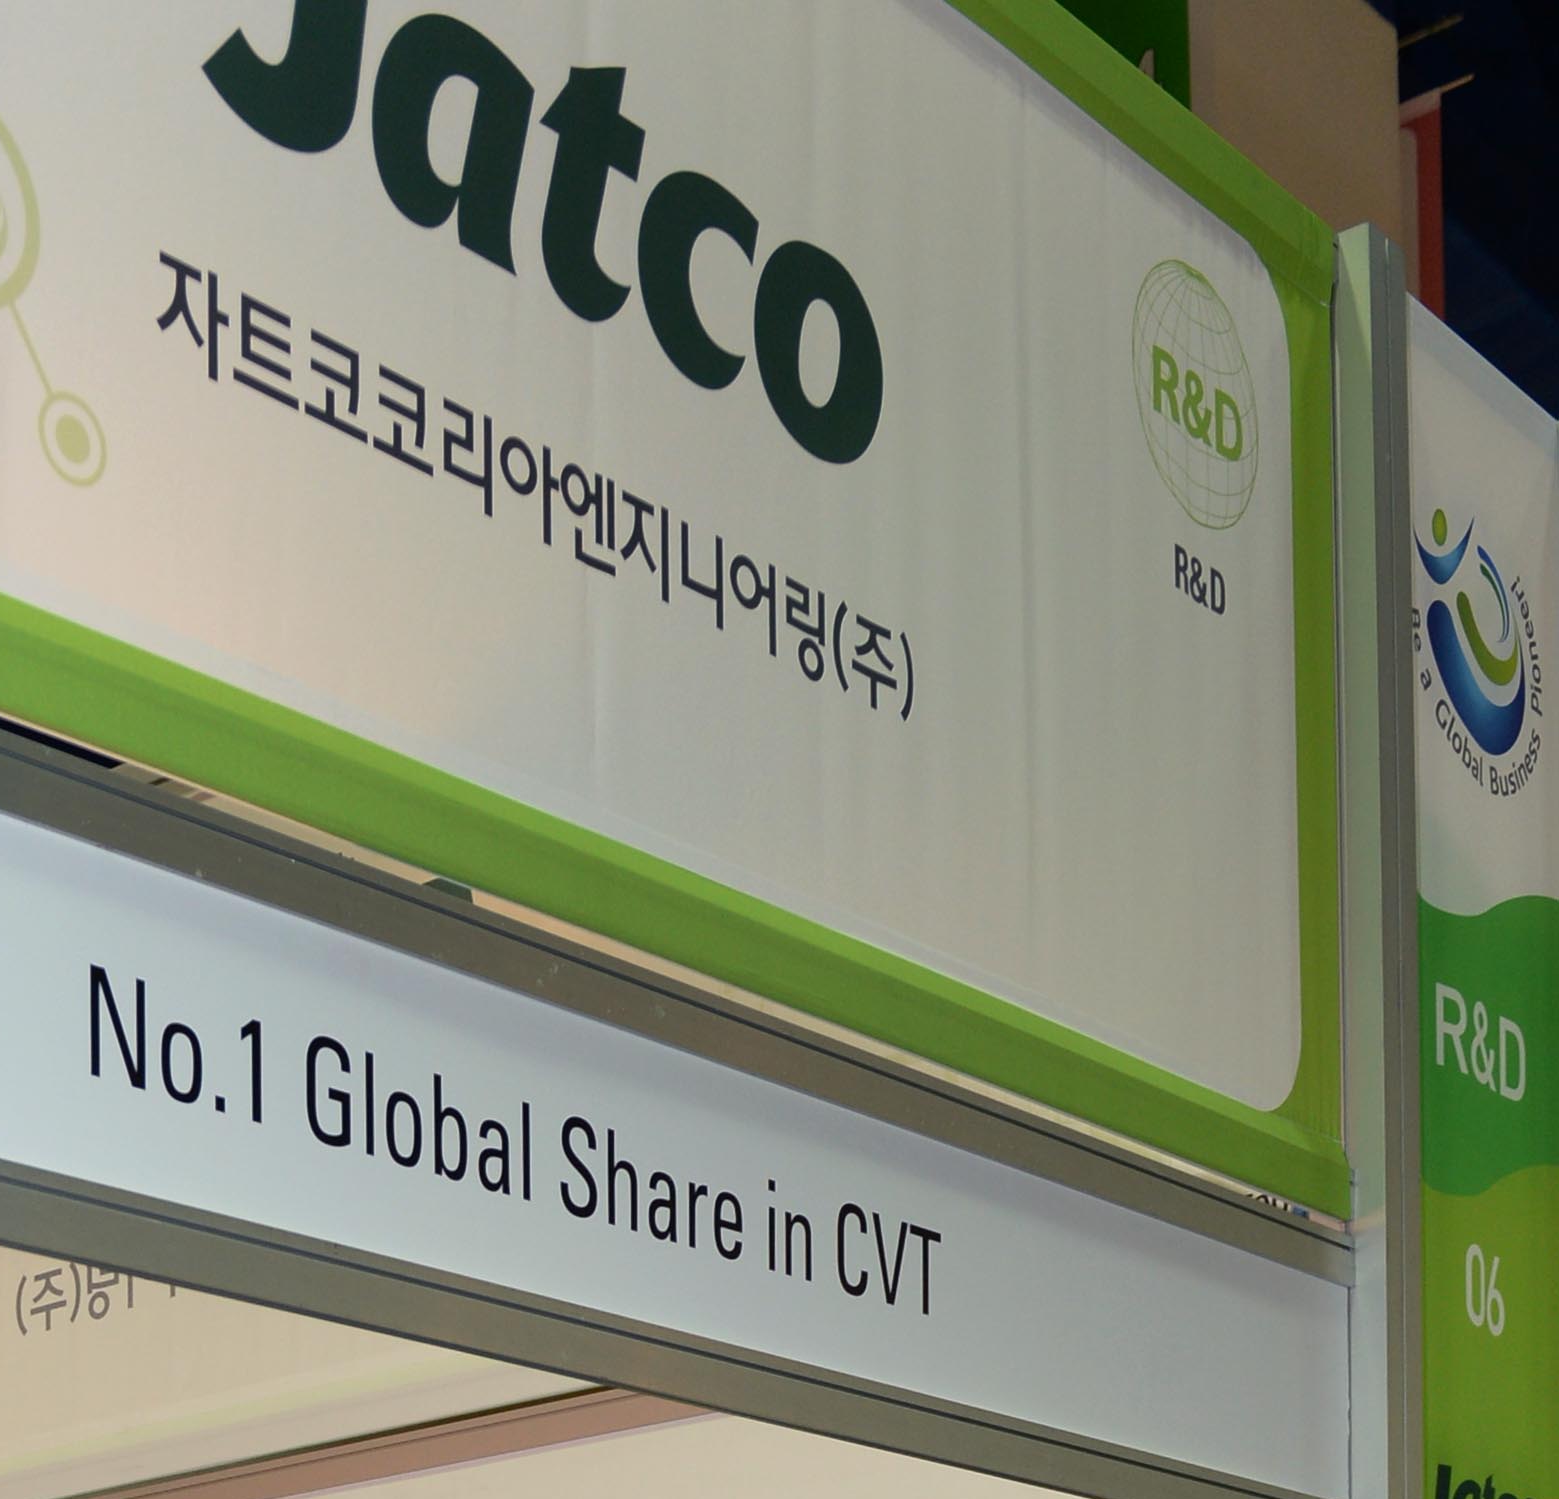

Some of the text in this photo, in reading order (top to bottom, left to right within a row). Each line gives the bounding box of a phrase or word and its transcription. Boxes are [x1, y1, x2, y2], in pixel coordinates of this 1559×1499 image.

[201, 0, 885, 466] Jatco
[1151, 345, 1243, 462] R&D
[156, 250, 915, 721] 자트코코리아엔지니어링(주)
[1174, 543, 1227, 616] R&D
[1420, 667, 1432, 691] a
[1435, 698, 1484, 787] Global
[1489, 728, 1541, 797] Business
[1436, 981, 1527, 1102] R&D
[88, 962, 943, 1316] No.1 Global Share in CVT
[1465, 1244, 1506, 1337] 06
